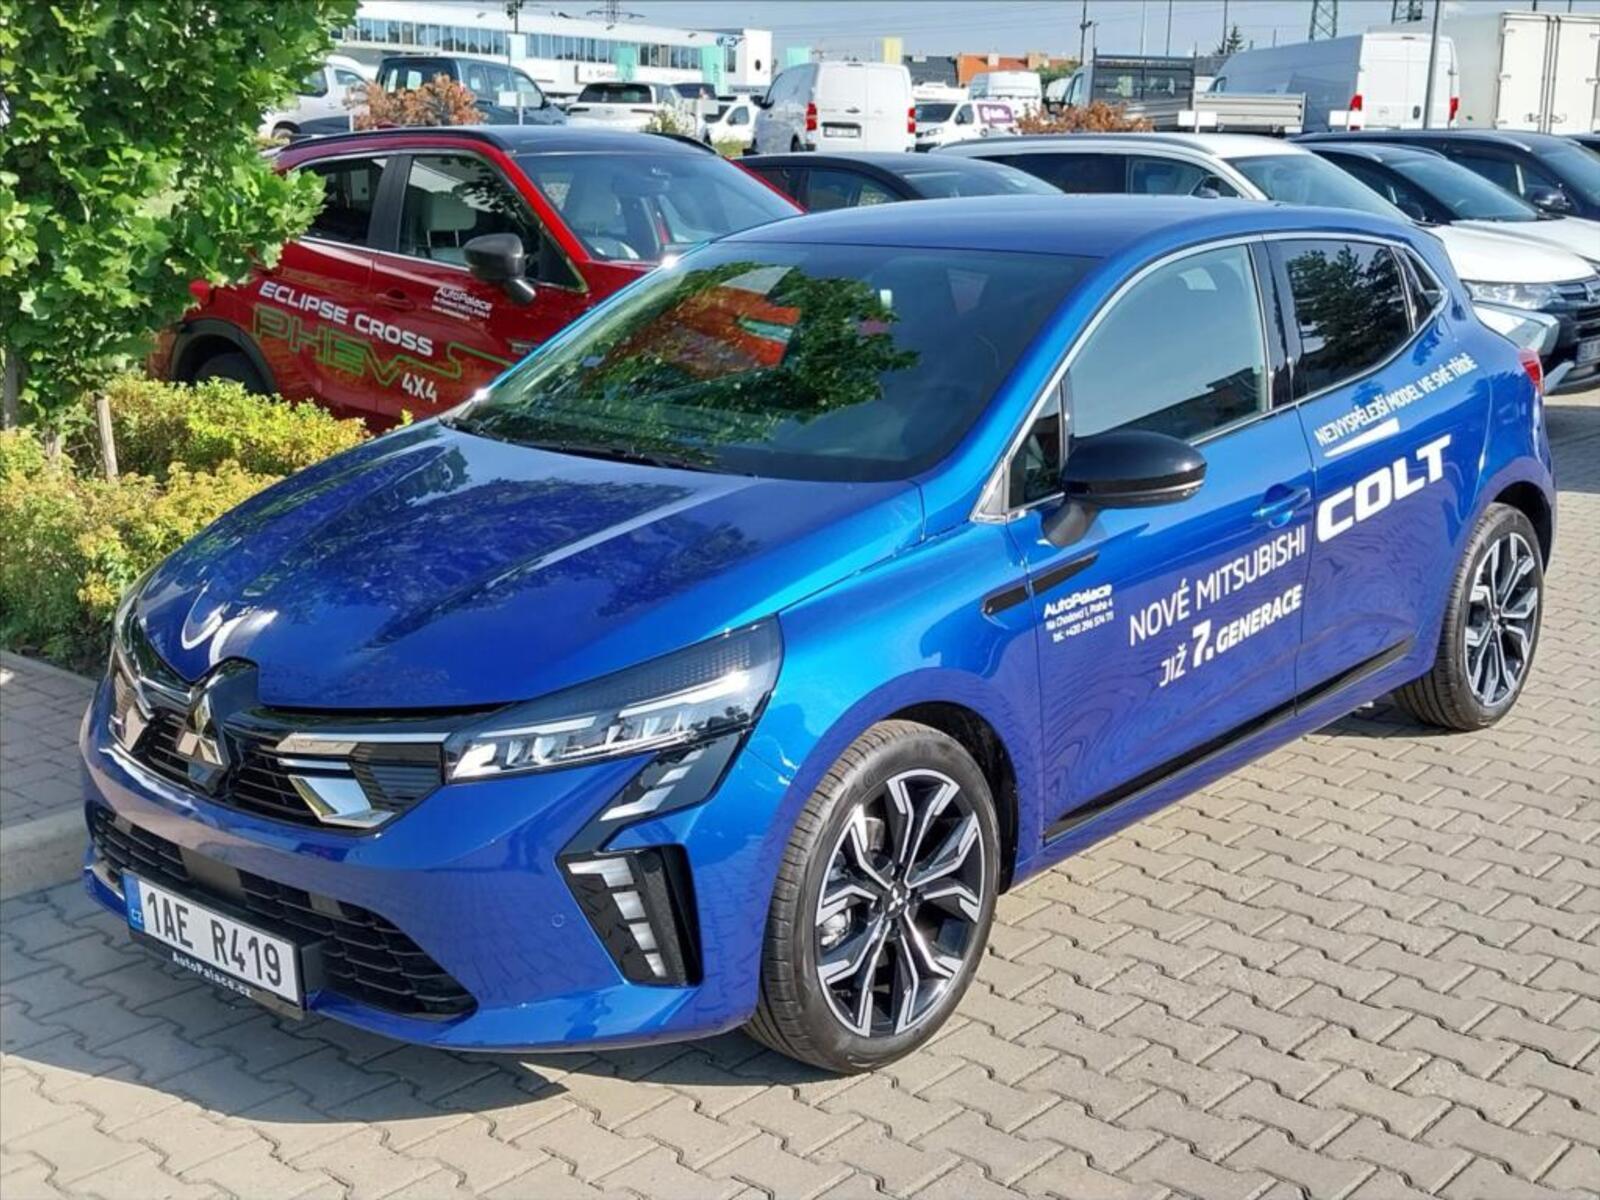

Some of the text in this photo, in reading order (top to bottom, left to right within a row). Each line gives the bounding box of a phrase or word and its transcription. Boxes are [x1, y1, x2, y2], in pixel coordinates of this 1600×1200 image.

[259, 281, 434, 357] ECLIPSE CROSS
[436, 285, 493, 312] AutoPalace
[253, 304, 402, 387] PHEV
[402, 373, 437, 403] 4X4
[1385, 384, 1424, 412] MODEL
[1417, 375, 1437, 393] VE
[1317, 434, 1452, 543] COLT
[1043, 583, 1113, 619] AutoPalace
[1129, 524, 1306, 647] NOVÉ MITSUBISHI
[1159, 584, 1303, 688] JIŽ 7. GENERACE
[131, 908, 144, 924] CZ
[147, 892, 283, 988] 1AE R419
